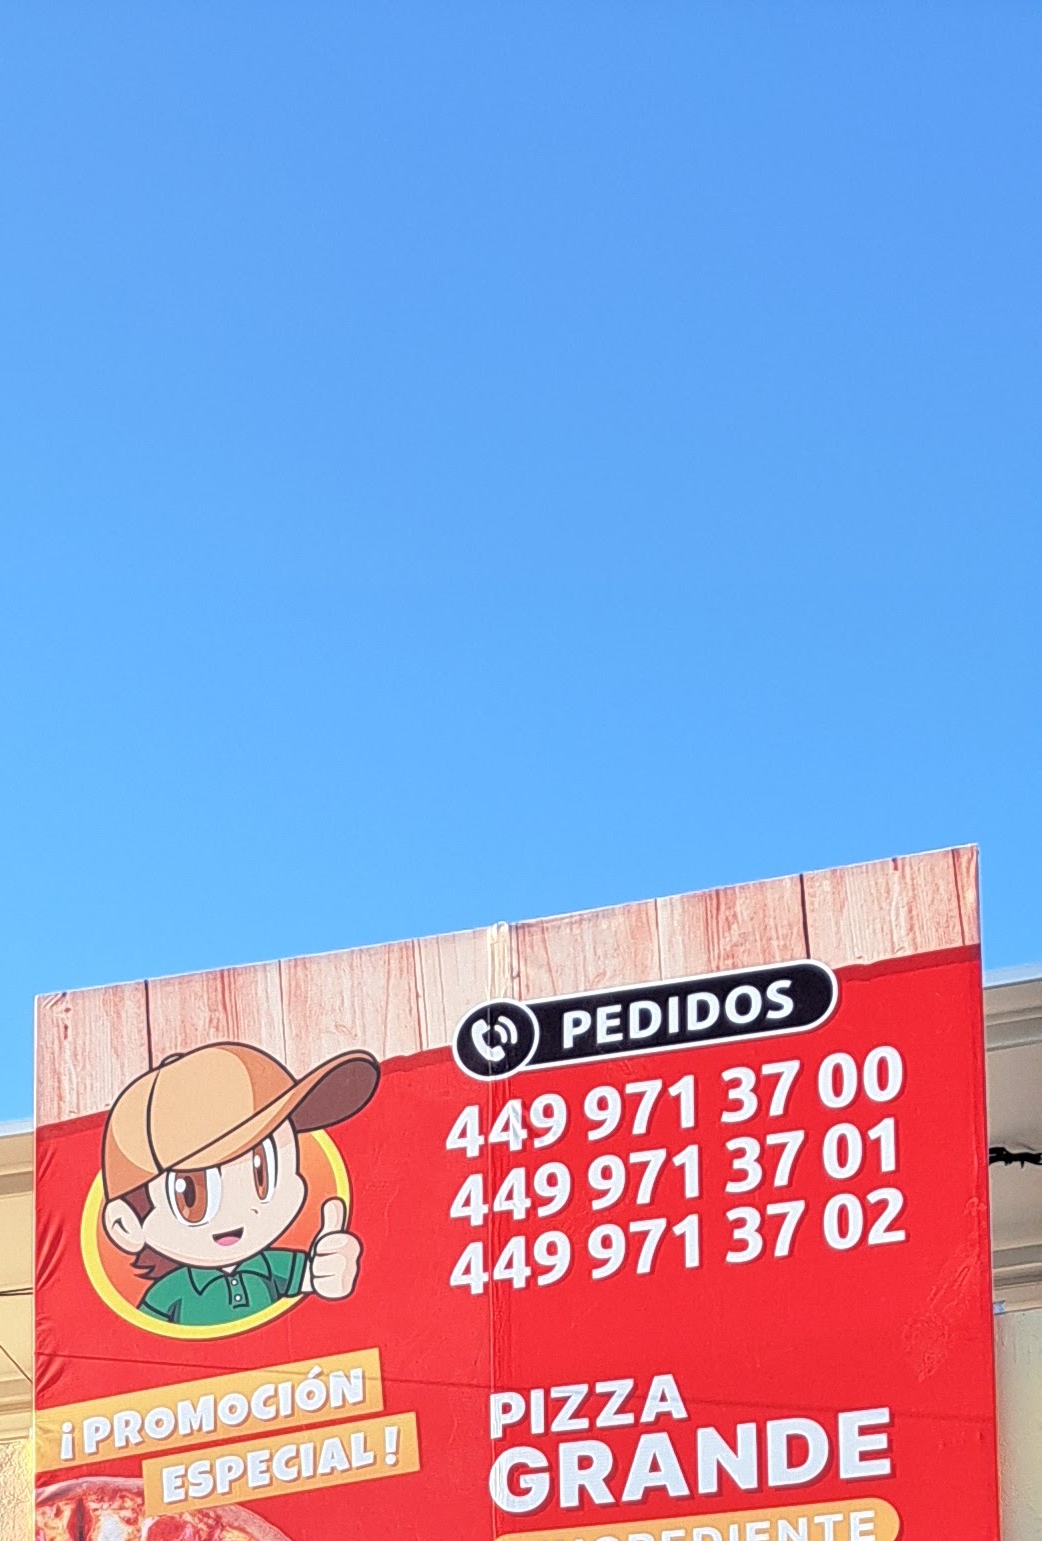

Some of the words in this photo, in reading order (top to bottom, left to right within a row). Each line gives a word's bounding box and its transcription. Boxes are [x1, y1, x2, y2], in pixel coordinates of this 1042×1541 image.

[562, 979, 794, 1049] PEDIDOS
[446, 1093, 567, 1158] 449
[583, 1074, 697, 1141] 971
[721, 1060, 801, 1123] 37
[818, 1045, 904, 1109] 00
[449, 1162, 571, 1227] 449
[587, 1144, 699, 1211] 971
[725, 1129, 805, 1193] 37
[822, 1117, 896, 1180] 01
[449, 1229, 571, 1295] 449
[587, 1213, 699, 1279] 971
[726, 1199, 806, 1263] 37
[823, 1187, 906, 1250] 02
[489, 1373, 688, 1439] PIZZA
[488, 1407, 892, 1513] GRANDE
